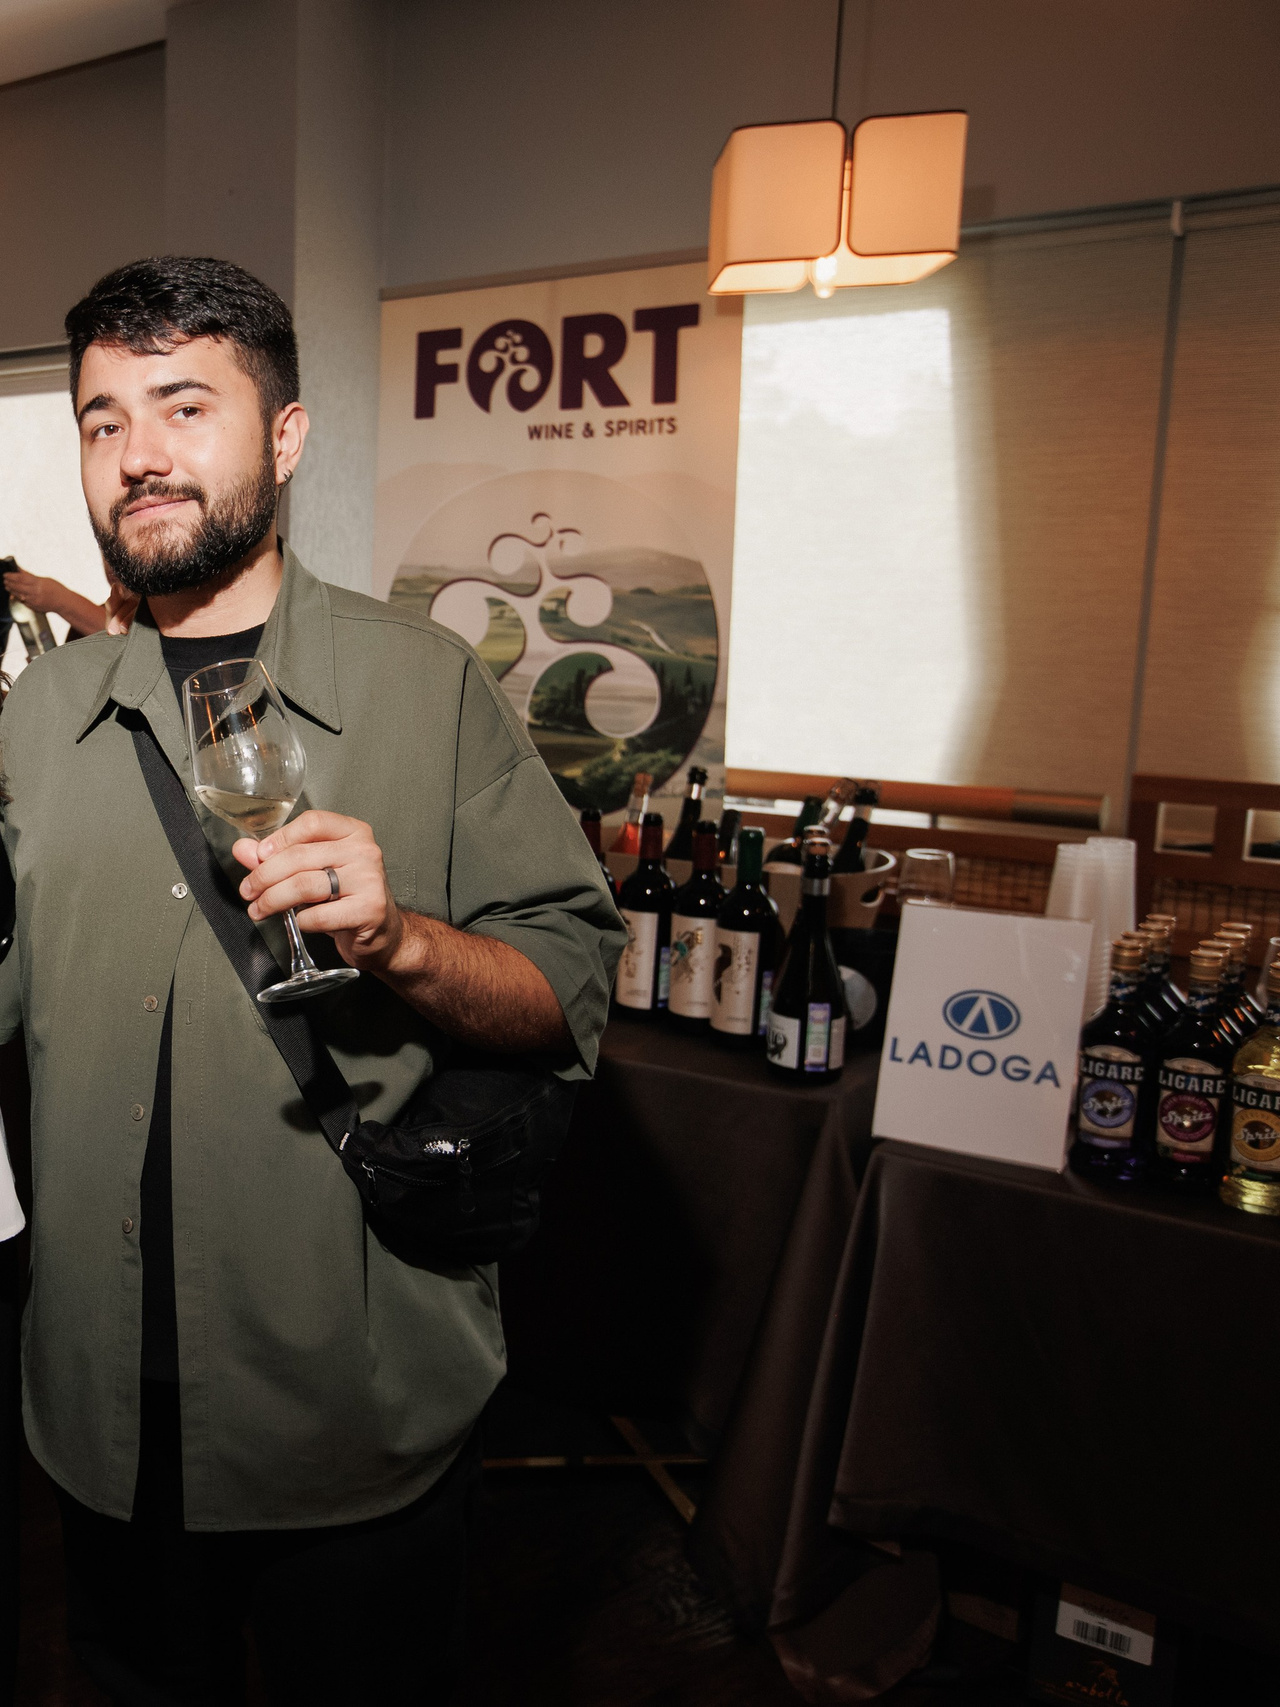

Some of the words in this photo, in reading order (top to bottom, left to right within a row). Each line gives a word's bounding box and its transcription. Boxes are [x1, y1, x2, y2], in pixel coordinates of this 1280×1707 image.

[414, 303, 700, 420] FORT
[528, 423, 574, 440] WINE
[582, 424, 594, 438] &
[604, 417, 677, 438] SPIRITS
[889, 1037, 1060, 1088] LADOGA
[1159, 1069, 1226, 1094] LIGARE
